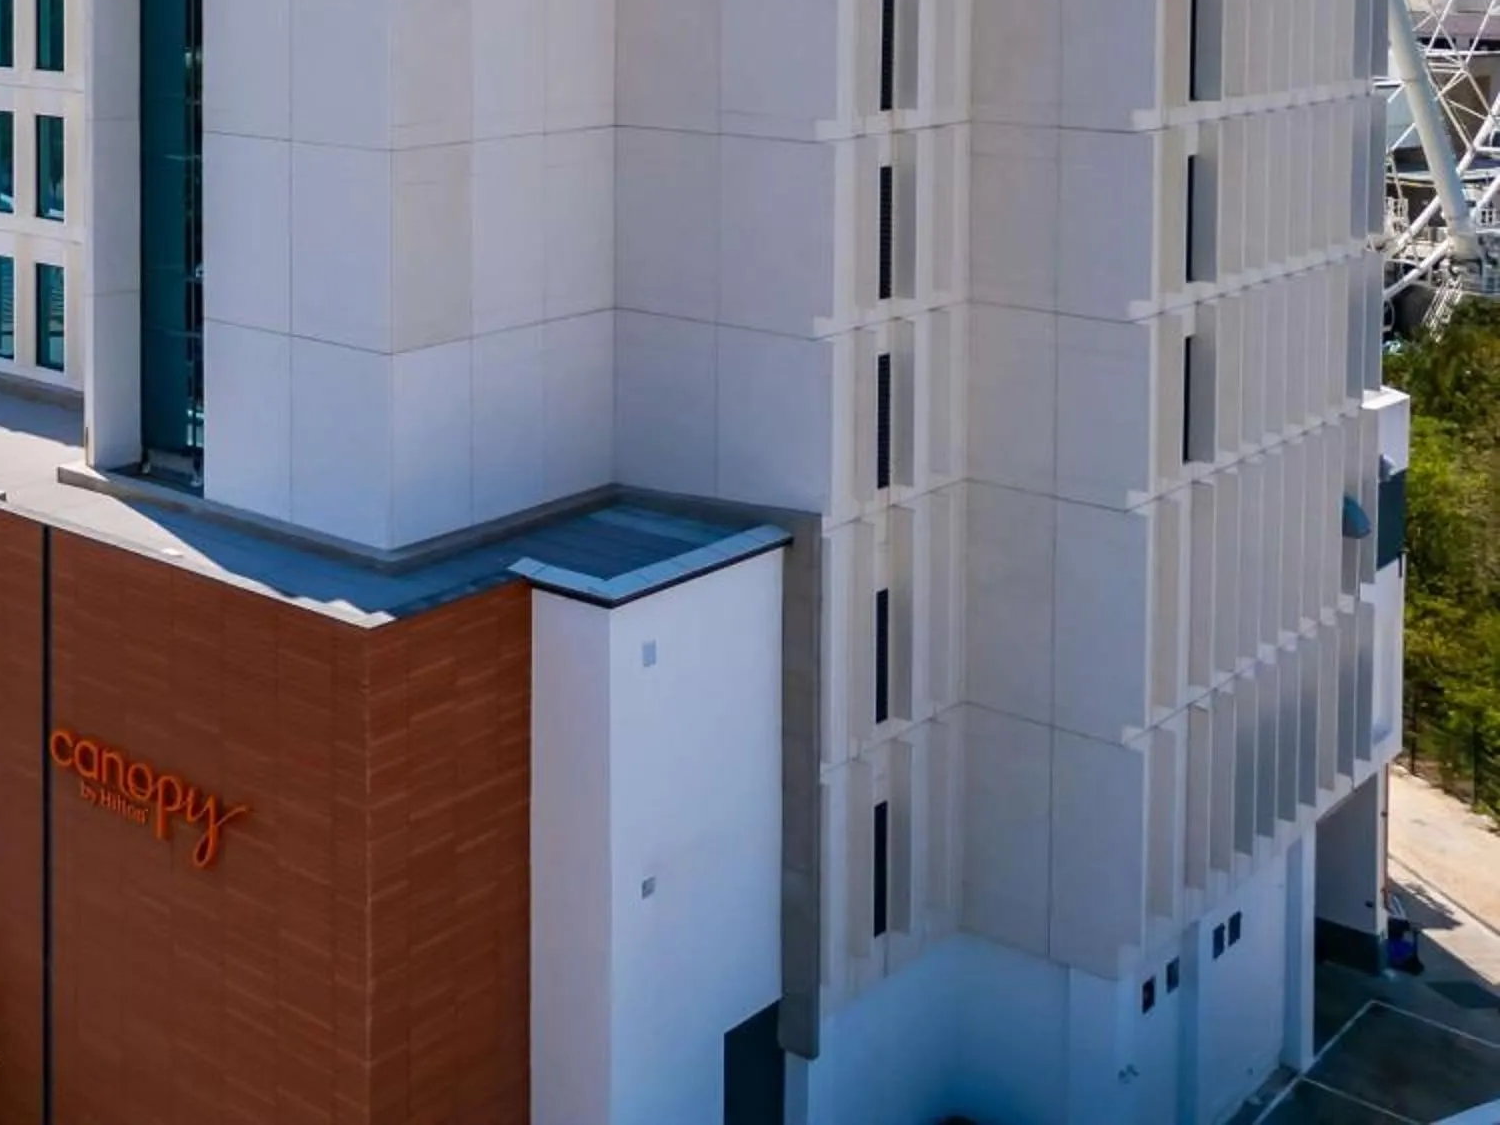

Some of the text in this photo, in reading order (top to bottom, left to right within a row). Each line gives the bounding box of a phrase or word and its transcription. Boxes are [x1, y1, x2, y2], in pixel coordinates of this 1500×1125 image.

[50, 730, 249, 867] canopy
[81, 781, 146, 824] by Hilton
